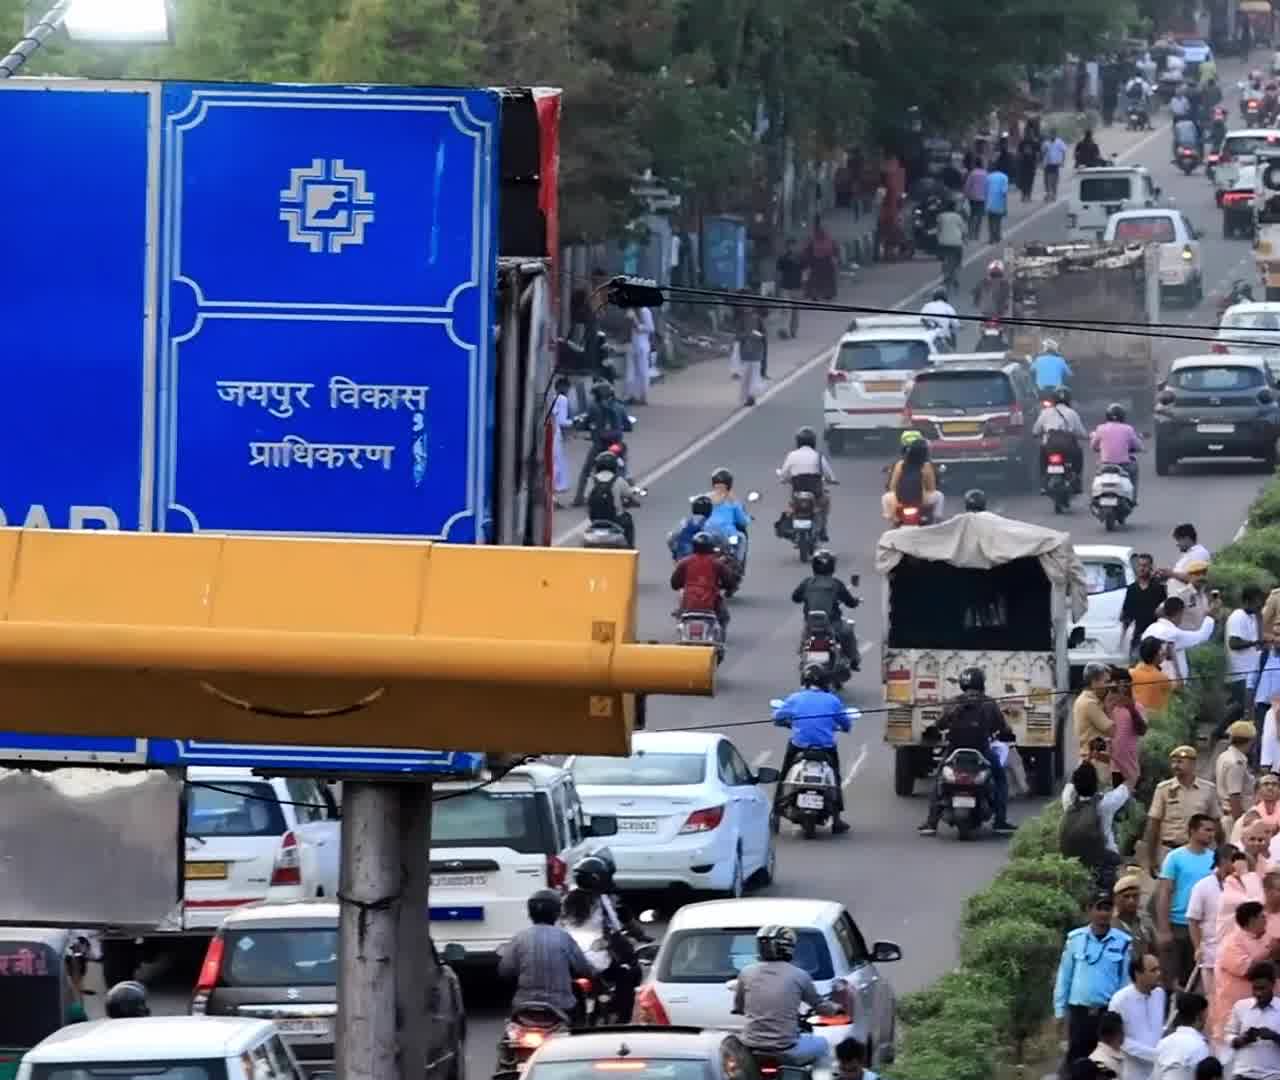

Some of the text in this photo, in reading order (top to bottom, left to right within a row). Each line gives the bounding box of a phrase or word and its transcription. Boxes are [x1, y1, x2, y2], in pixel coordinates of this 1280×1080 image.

[216, 375, 430, 418] जयपुर विकास
[248, 434, 396, 470] प्राधिकरण
